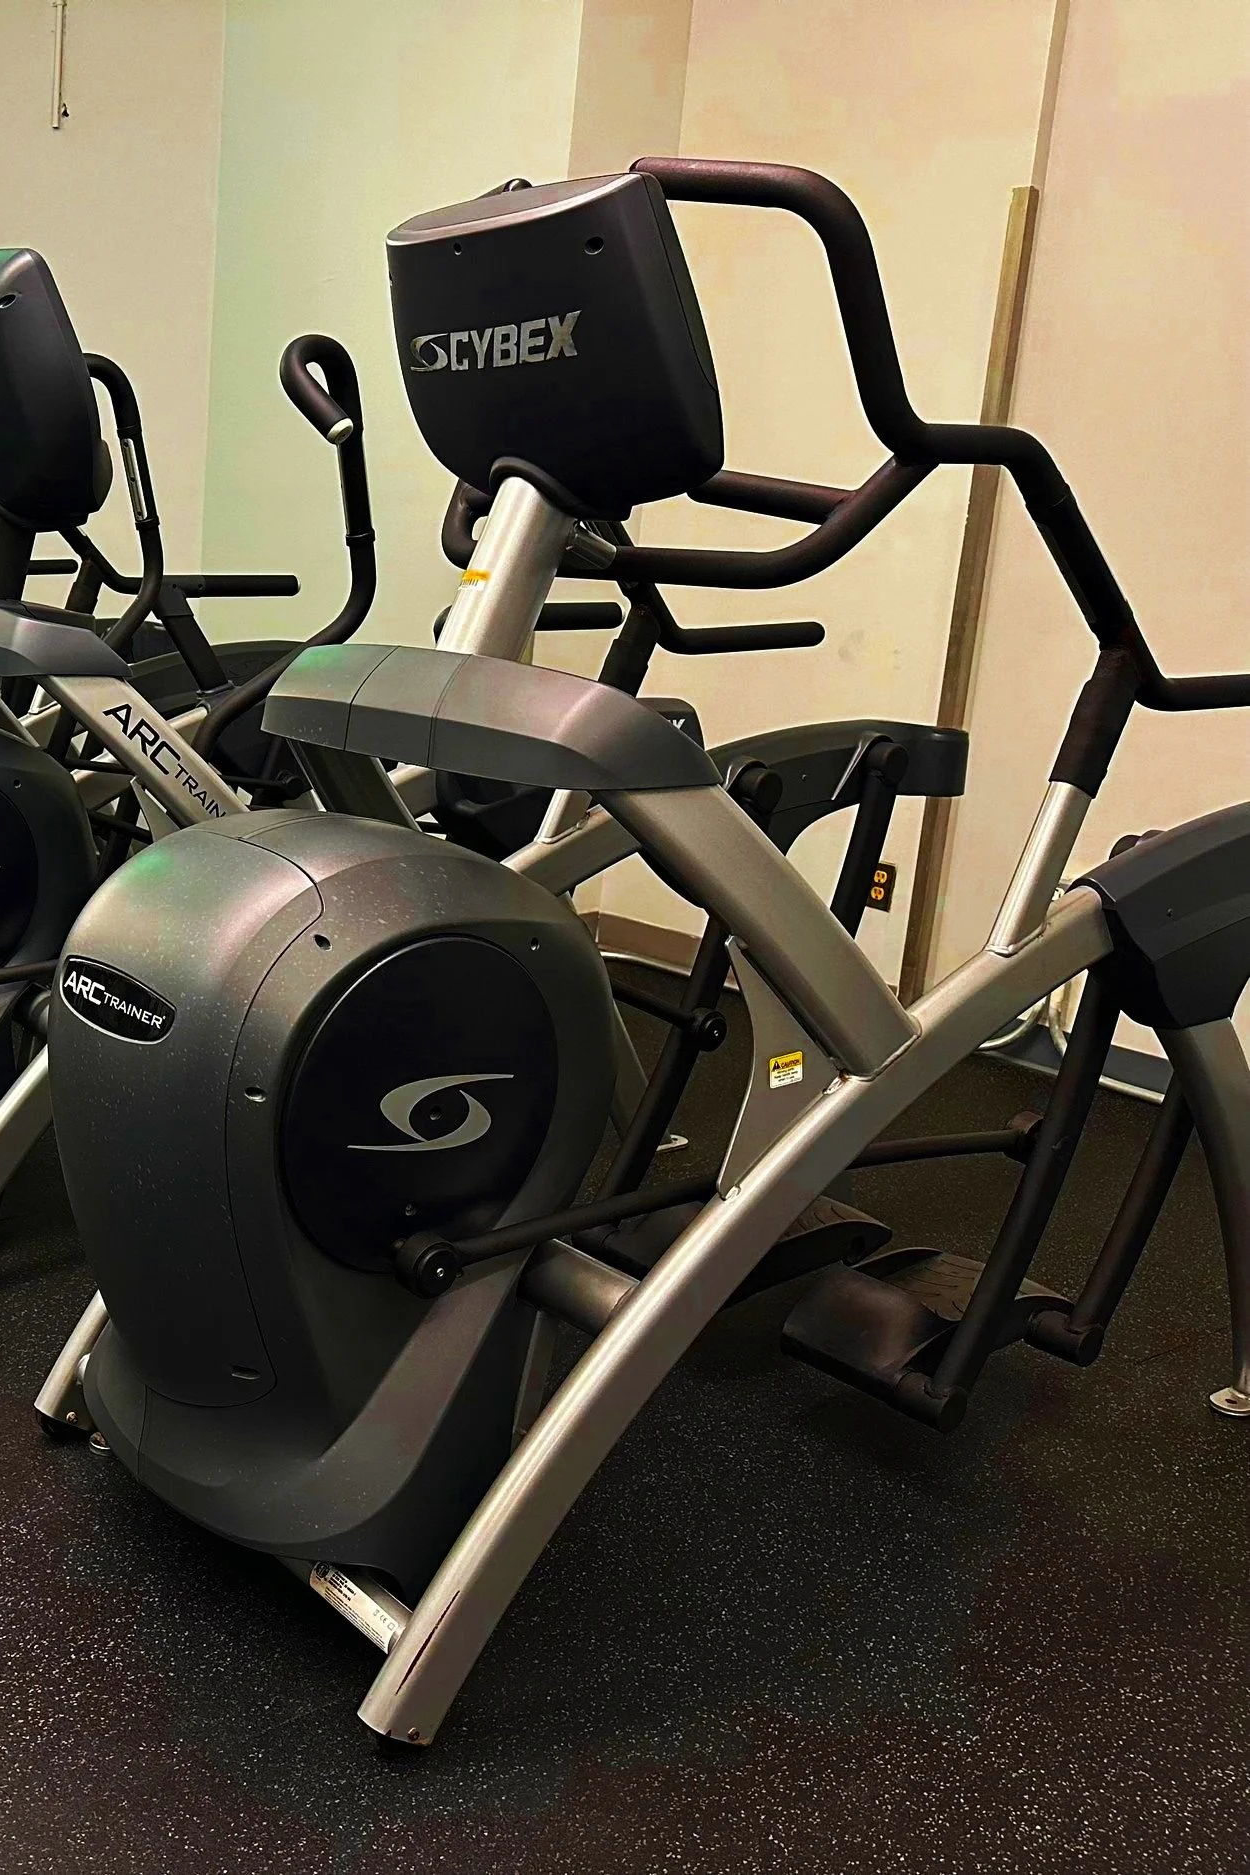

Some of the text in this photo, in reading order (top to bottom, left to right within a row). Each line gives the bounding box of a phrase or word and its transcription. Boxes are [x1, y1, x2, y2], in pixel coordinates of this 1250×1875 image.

[449, 310, 583, 372] CYBEX
[102, 703, 181, 776] ARC
[63, 970, 106, 1006] ARC
